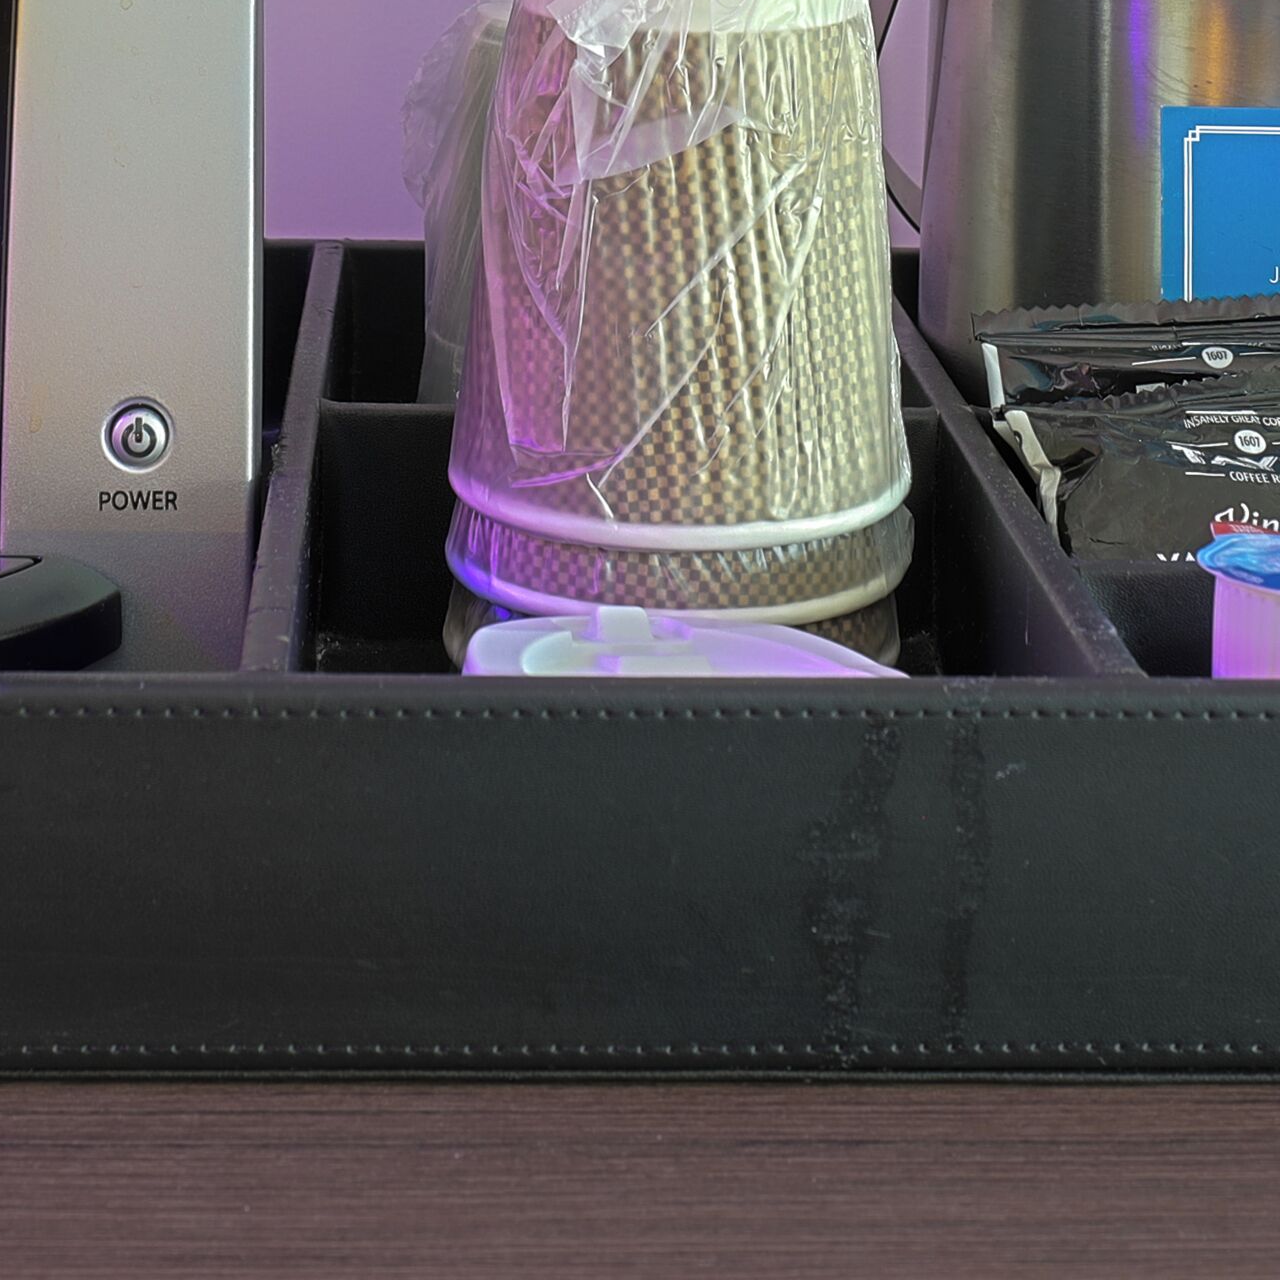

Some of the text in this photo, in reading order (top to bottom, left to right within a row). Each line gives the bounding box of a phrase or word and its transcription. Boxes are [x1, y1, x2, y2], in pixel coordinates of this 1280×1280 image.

[1205, 350, 1228, 361] 1607
[1184, 415, 1229, 429] INSANELY
[1238, 434, 1261, 448] 1607
[1229, 471, 1270, 484] COFFEE
[99, 490, 178, 512] POWER
